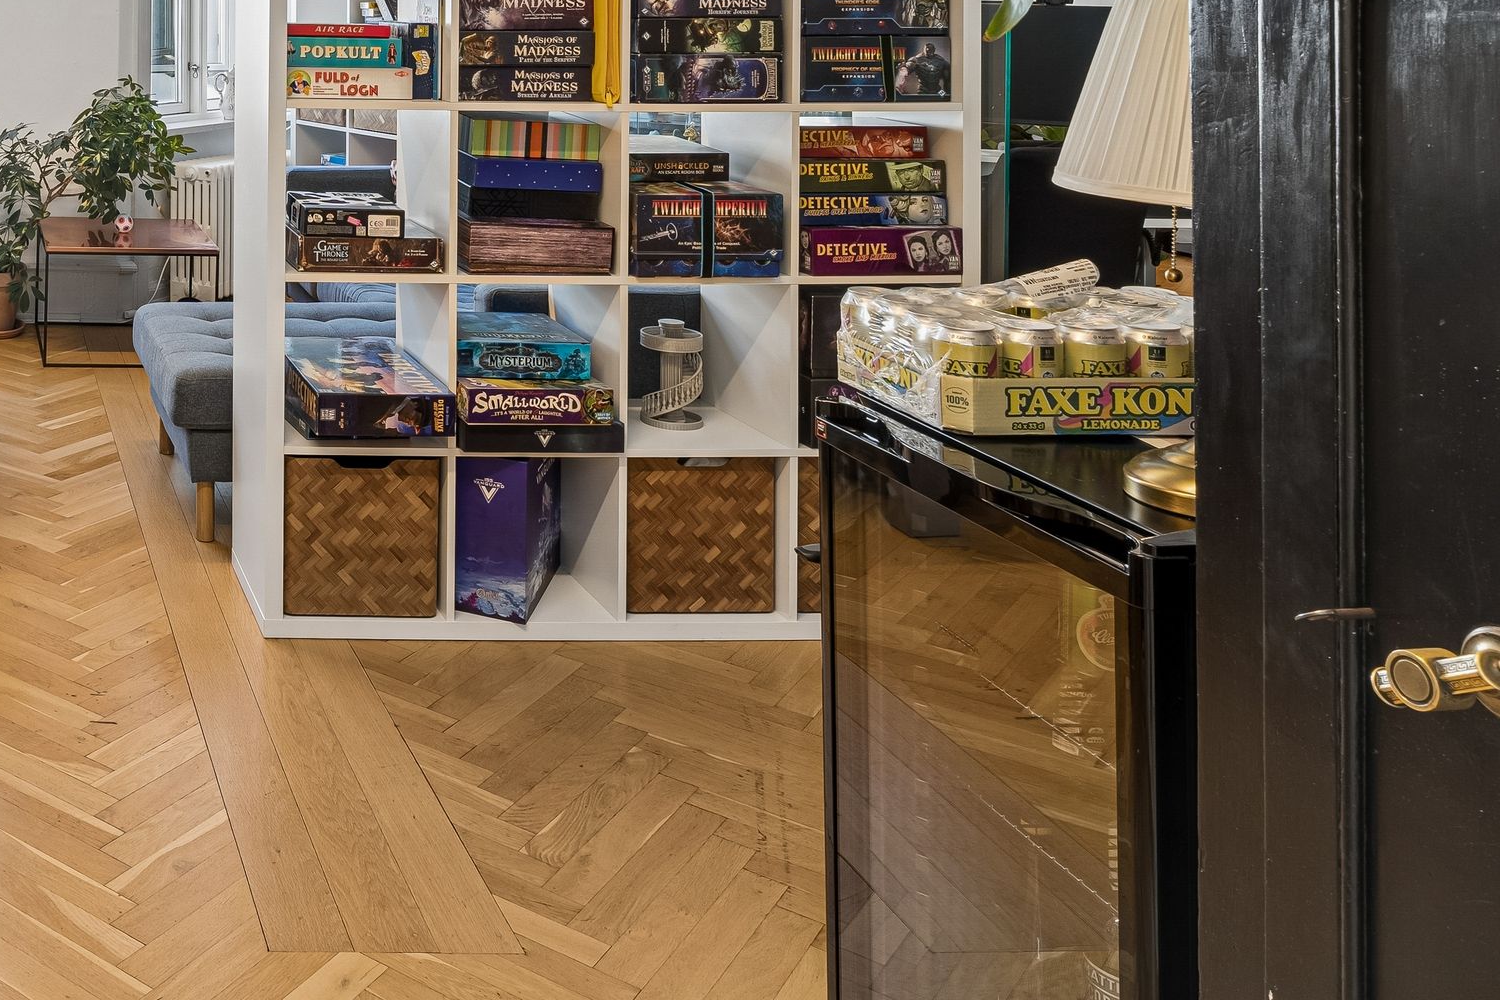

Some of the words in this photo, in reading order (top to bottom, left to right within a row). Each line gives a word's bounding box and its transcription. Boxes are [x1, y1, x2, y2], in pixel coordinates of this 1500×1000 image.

[517, 34, 563, 45] MANSIONS
[300, 45, 382, 60] POPKULT
[514, 45, 581, 57] MADNESS
[811, 47, 857, 61] TWILIGHT
[859, 47, 906, 61] IMPEUM
[315, 71, 350, 83] FULD
[514, 69, 560, 80] MANSIONS
[563, 71, 575, 79] OF
[340, 84, 379, 96] LØGN
[511, 80, 579, 92] MADNESS
[802, 130, 849, 142] ECTIVE
[799, 163, 869, 176] DETECTIVE
[652, 200, 702, 216] TWILIGH
[714, 200, 767, 216] MPERIUM
[799, 196, 869, 209] DETECTIVE
[317, 240, 341, 251] GAME
[816, 243, 888, 256] DETECTIVE
[313, 250, 349, 262] THRONES
[488, 354, 553, 370] MYSTERIUM
[472, 391, 581, 414] SMALLWORLD
[946, 395, 969, 406] 100%
[1005, 386, 1102, 417] FAXE
[1110, 386, 1194, 417] KON
[1082, 419, 1161, 431] LEMONADE
[473, 480, 505, 489] VANGUARD
